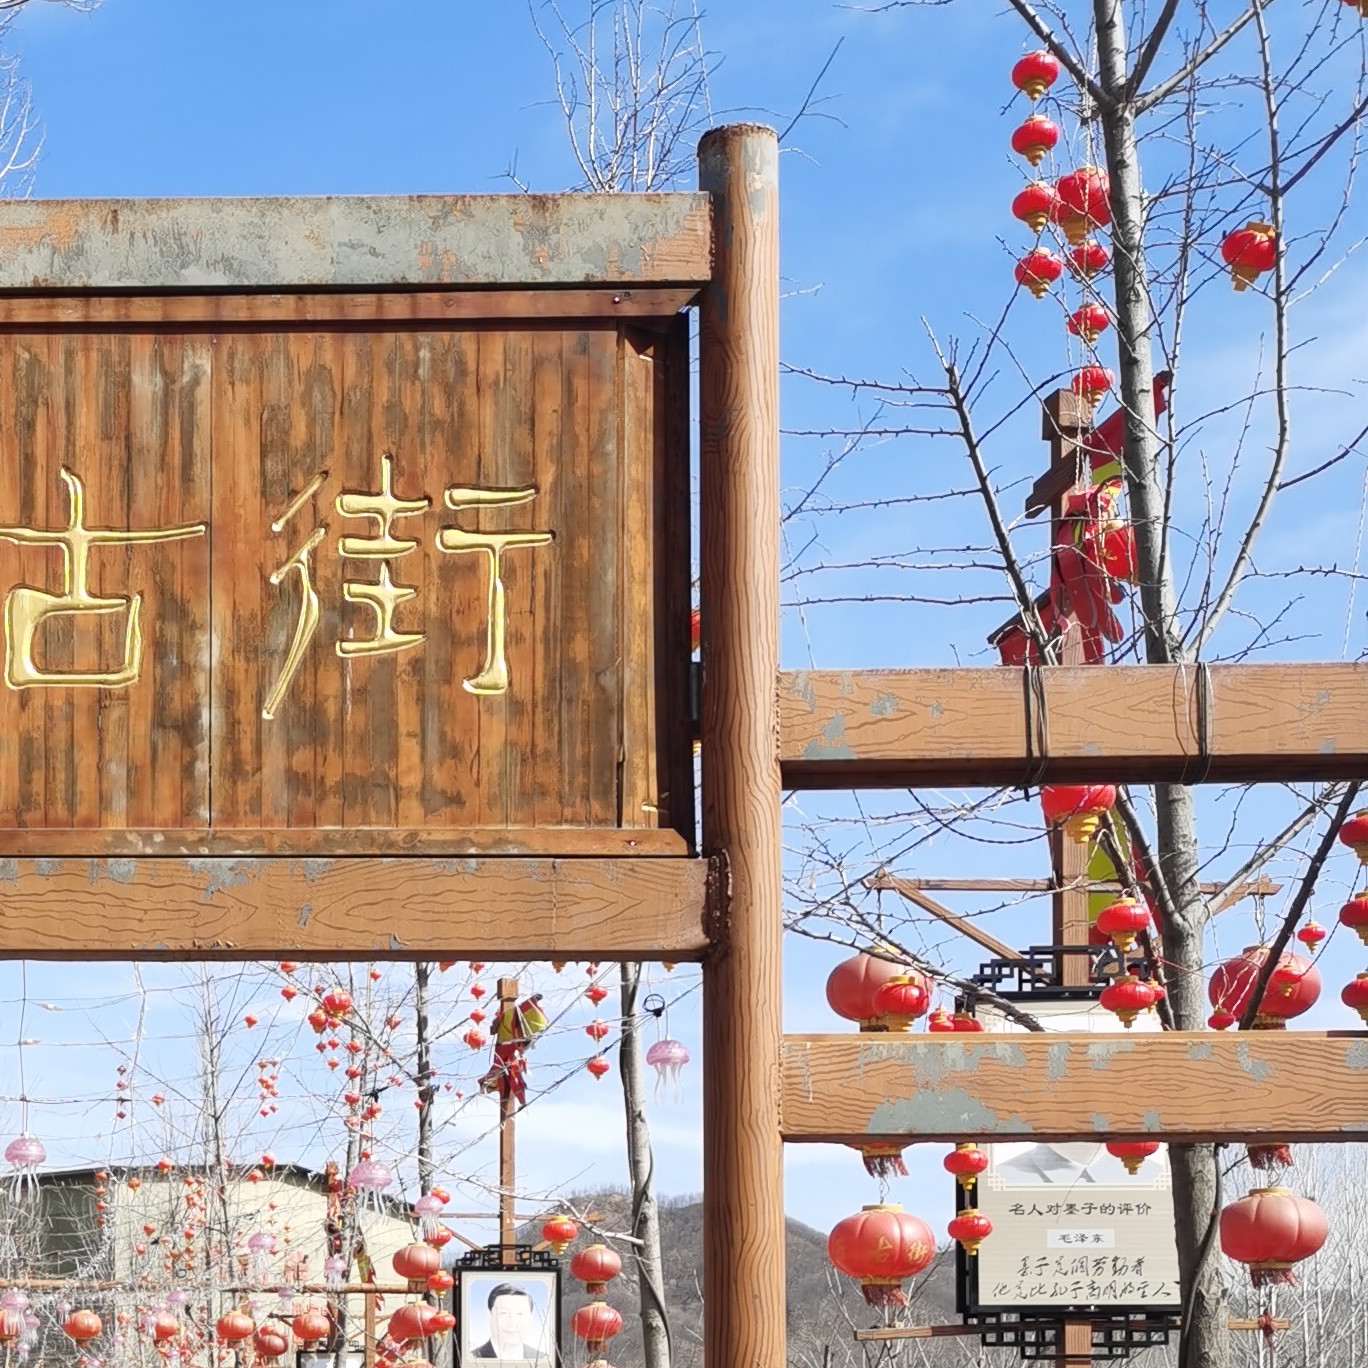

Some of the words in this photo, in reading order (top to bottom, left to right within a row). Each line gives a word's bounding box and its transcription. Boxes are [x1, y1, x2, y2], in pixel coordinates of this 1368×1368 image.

[1009, 1202, 1152, 1216] 名人对墨子的评价
[1058, 1234, 1105, 1244] 毛泽东
